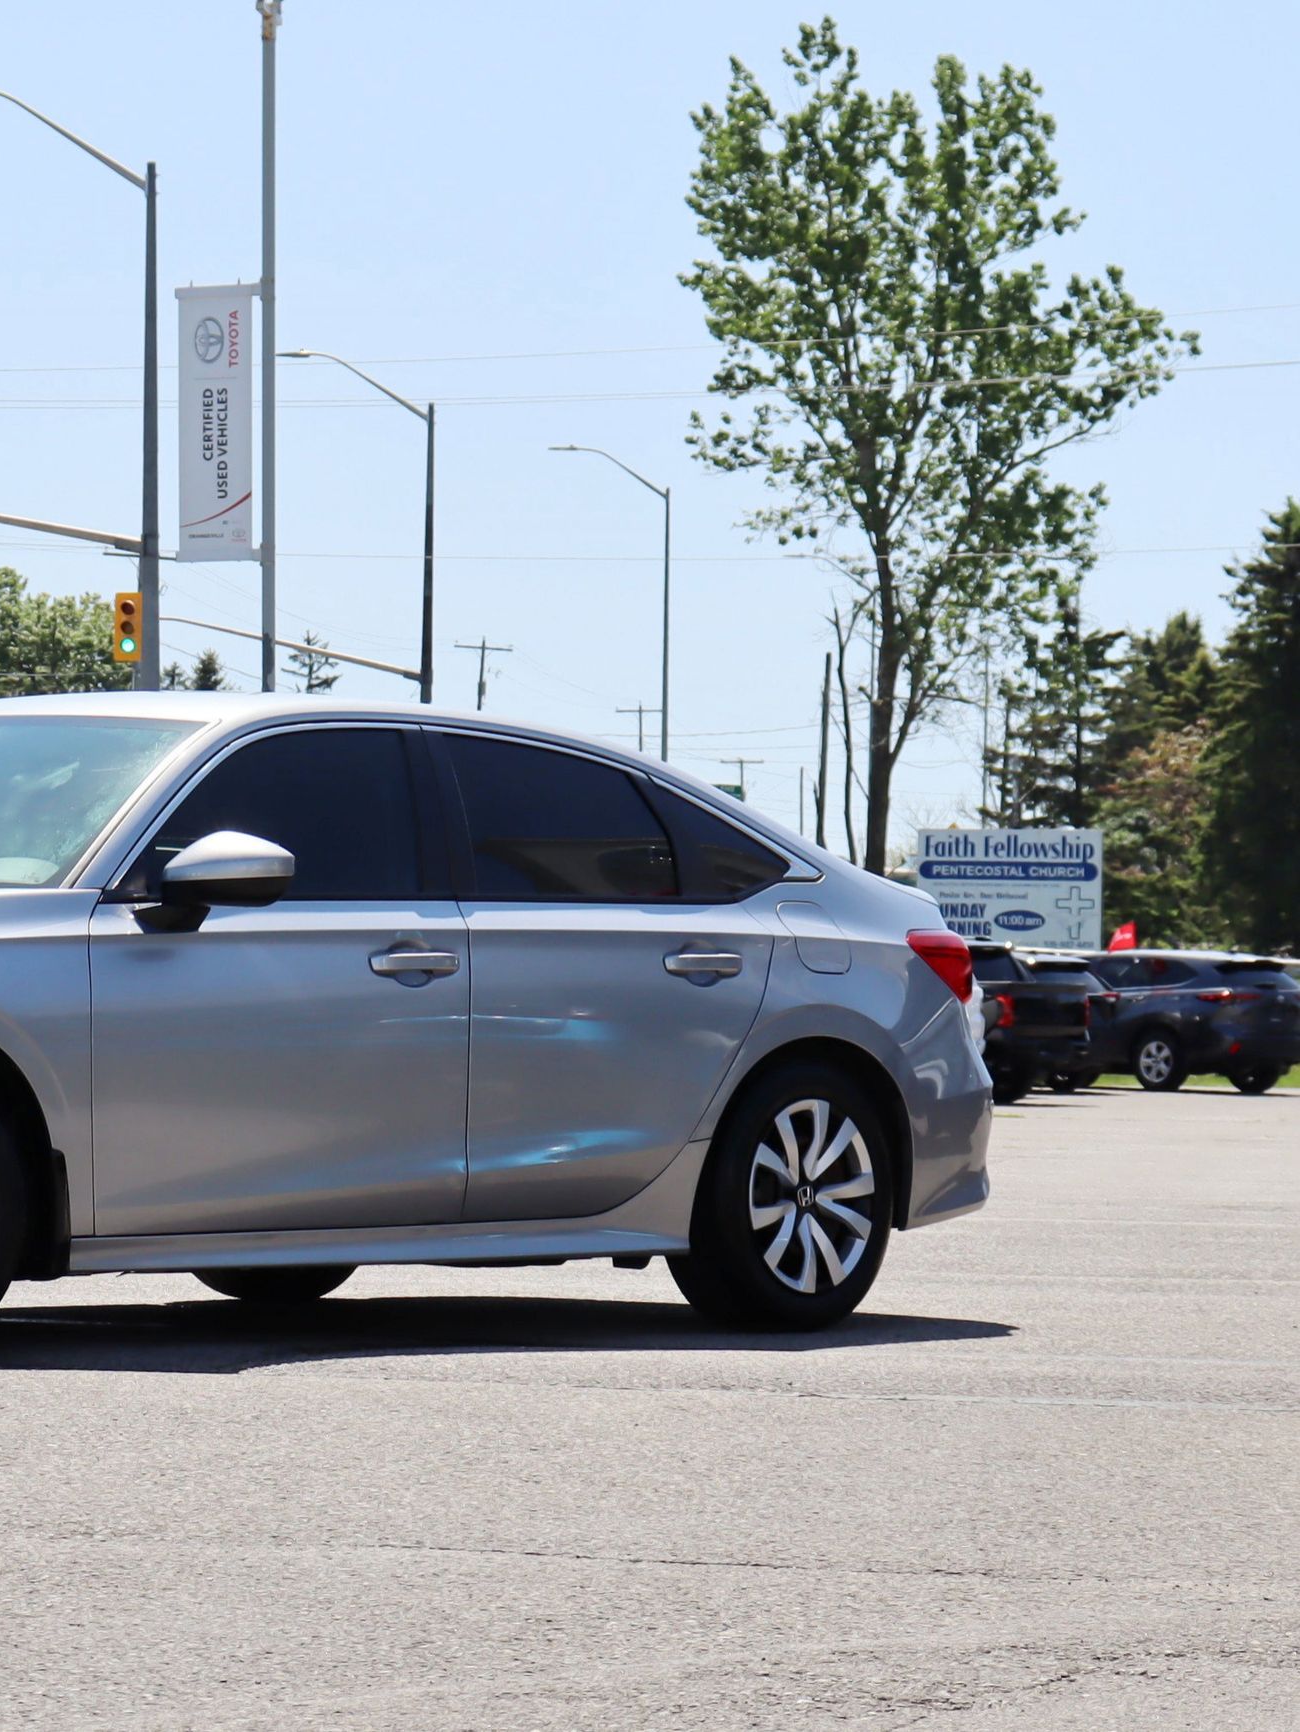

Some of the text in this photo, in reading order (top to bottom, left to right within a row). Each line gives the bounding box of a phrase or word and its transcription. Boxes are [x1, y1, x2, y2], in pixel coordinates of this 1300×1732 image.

[228, 310, 239, 368] TOYOTA
[203, 388, 214, 462] CERTIFIED
[217, 388, 228, 499] USED VEHICLES
[925, 834, 1094, 863] Faith Fellowship
[932, 865, 1085, 878] PENTECOSTAL CHURCH
[940, 903, 987, 918] UNDAY
[998, 915, 1024, 926] 11:00
[947, 921, 992, 936] RNING
